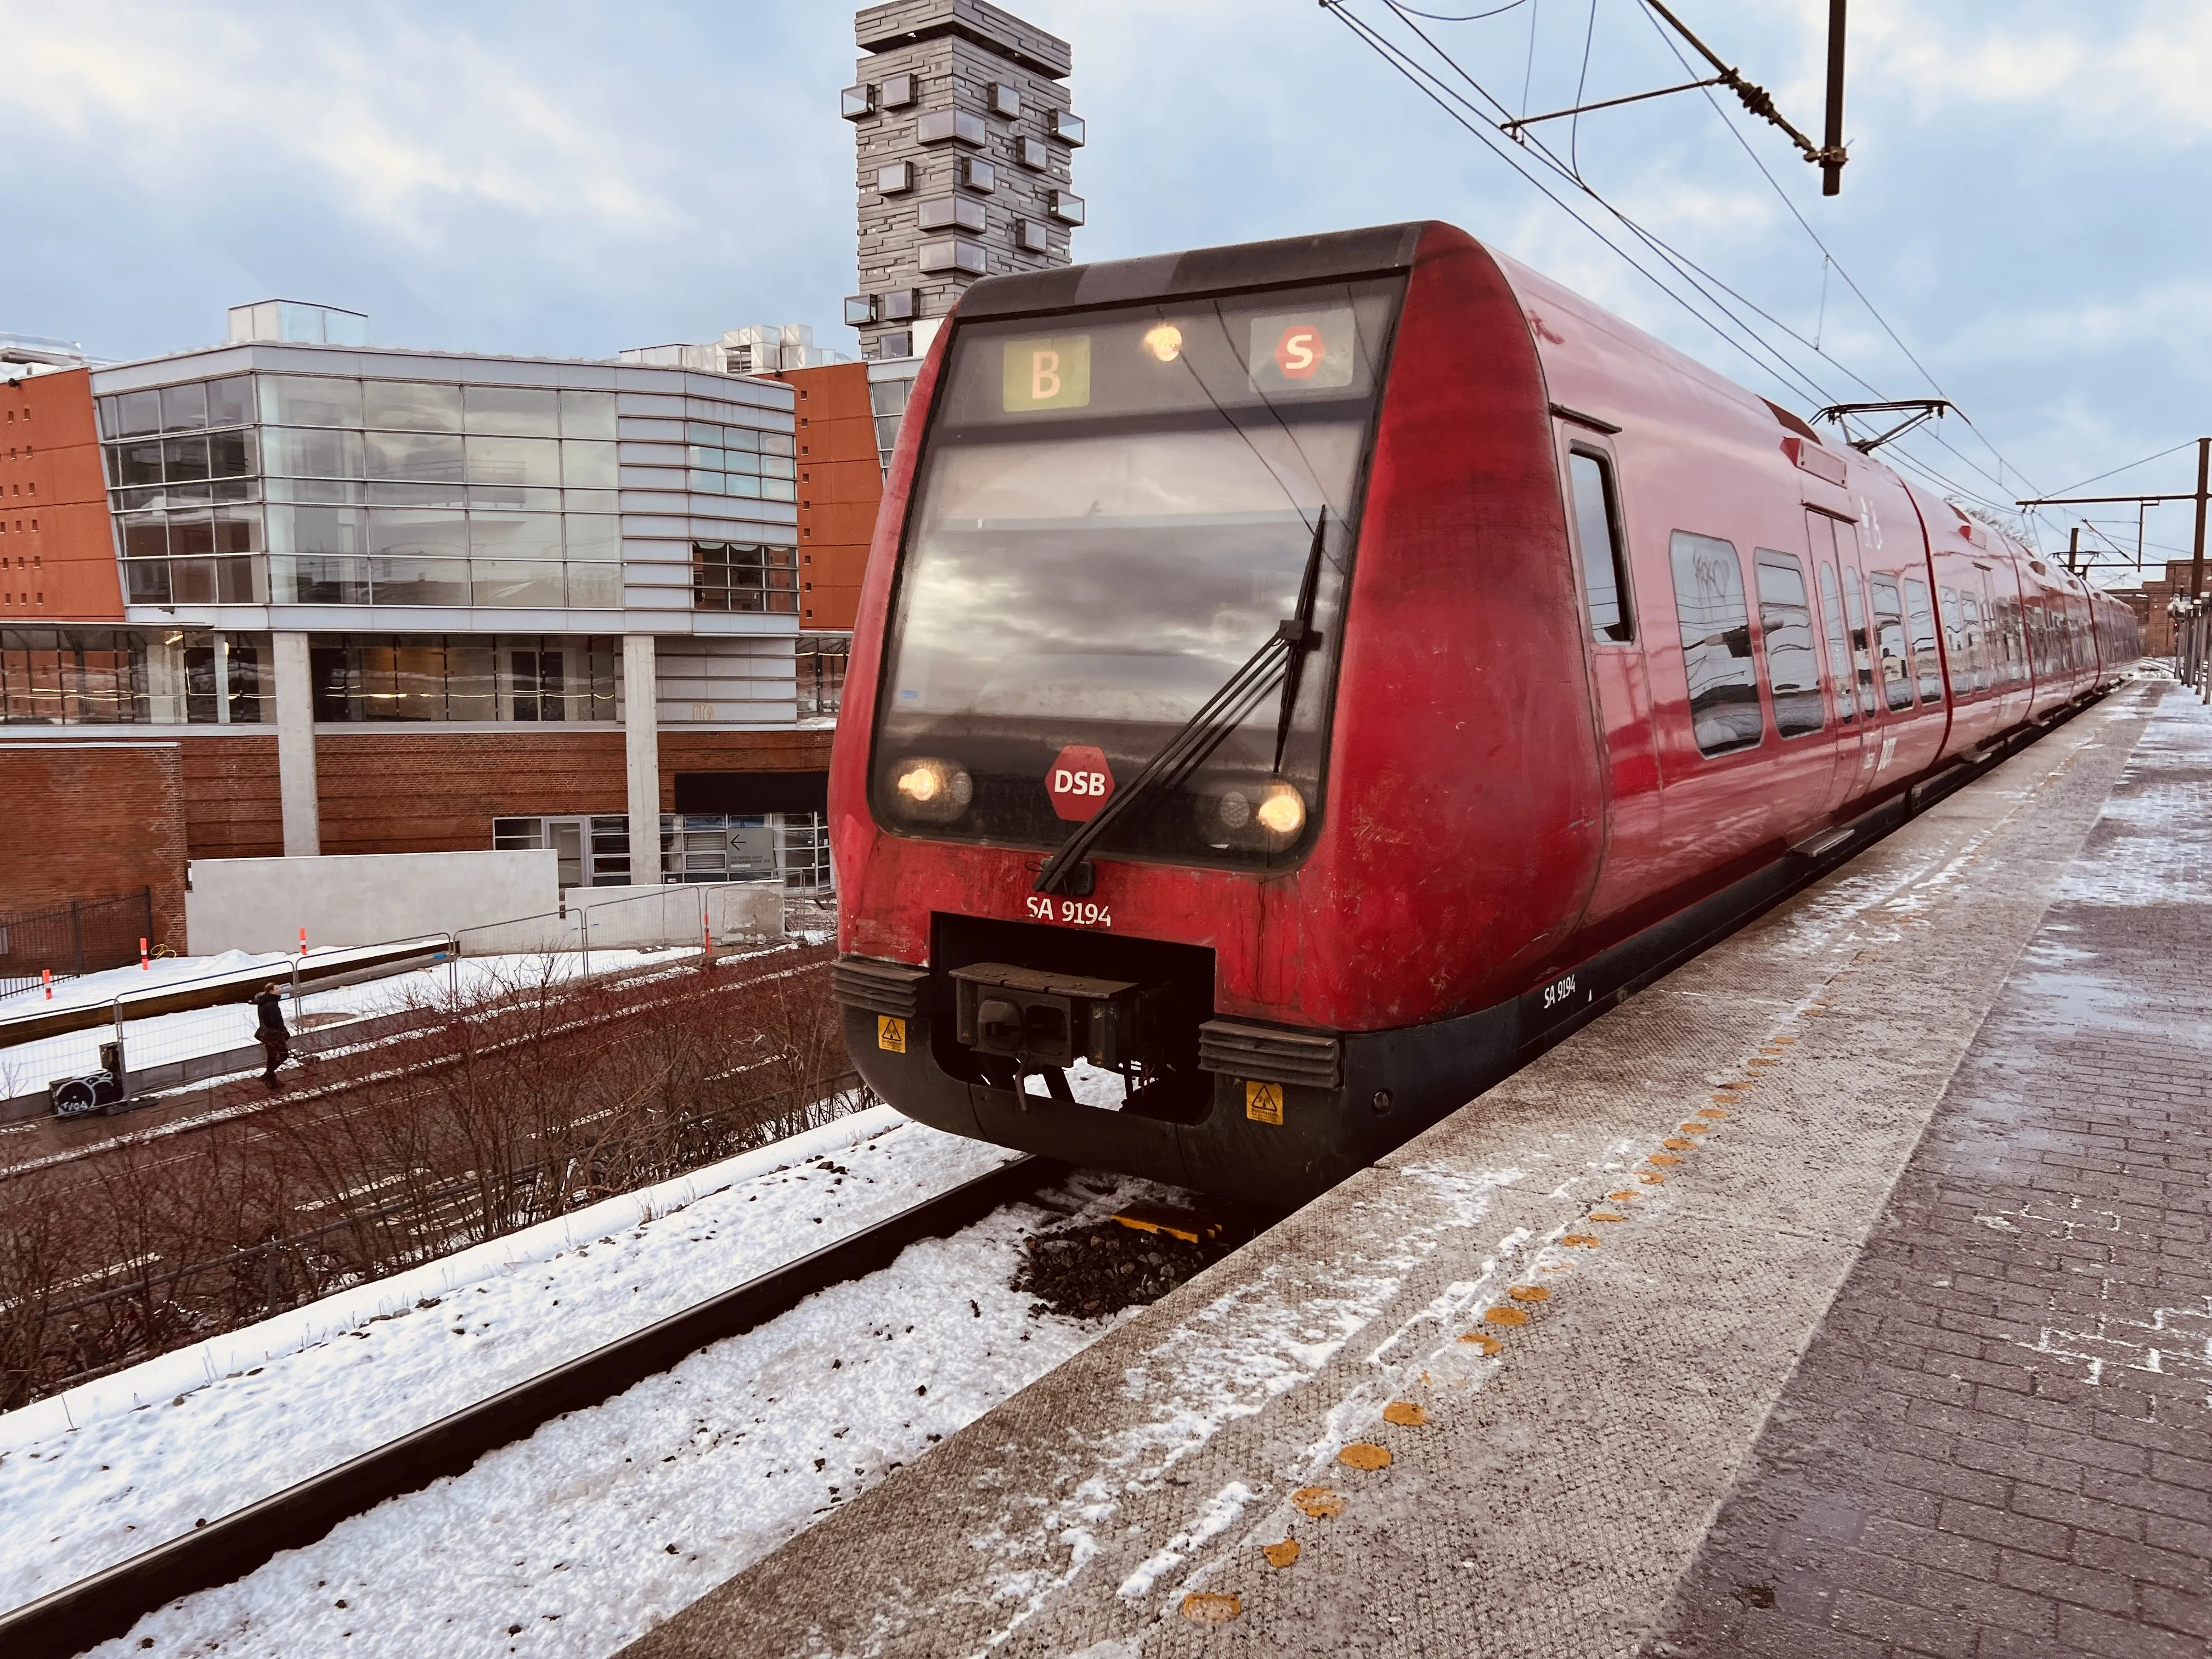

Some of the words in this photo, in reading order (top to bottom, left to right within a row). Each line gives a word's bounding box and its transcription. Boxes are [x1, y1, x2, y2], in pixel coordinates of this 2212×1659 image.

[1285, 334, 1313, 369] S
[1032, 351, 1060, 399] B
[1054, 770, 1105, 796] DSB
[1026, 896, 1054, 920] SA
[1062, 901, 1111, 927] 9194
[1544, 985, 1555, 1009] SA
[1558, 974, 1576, 1002] 9194
